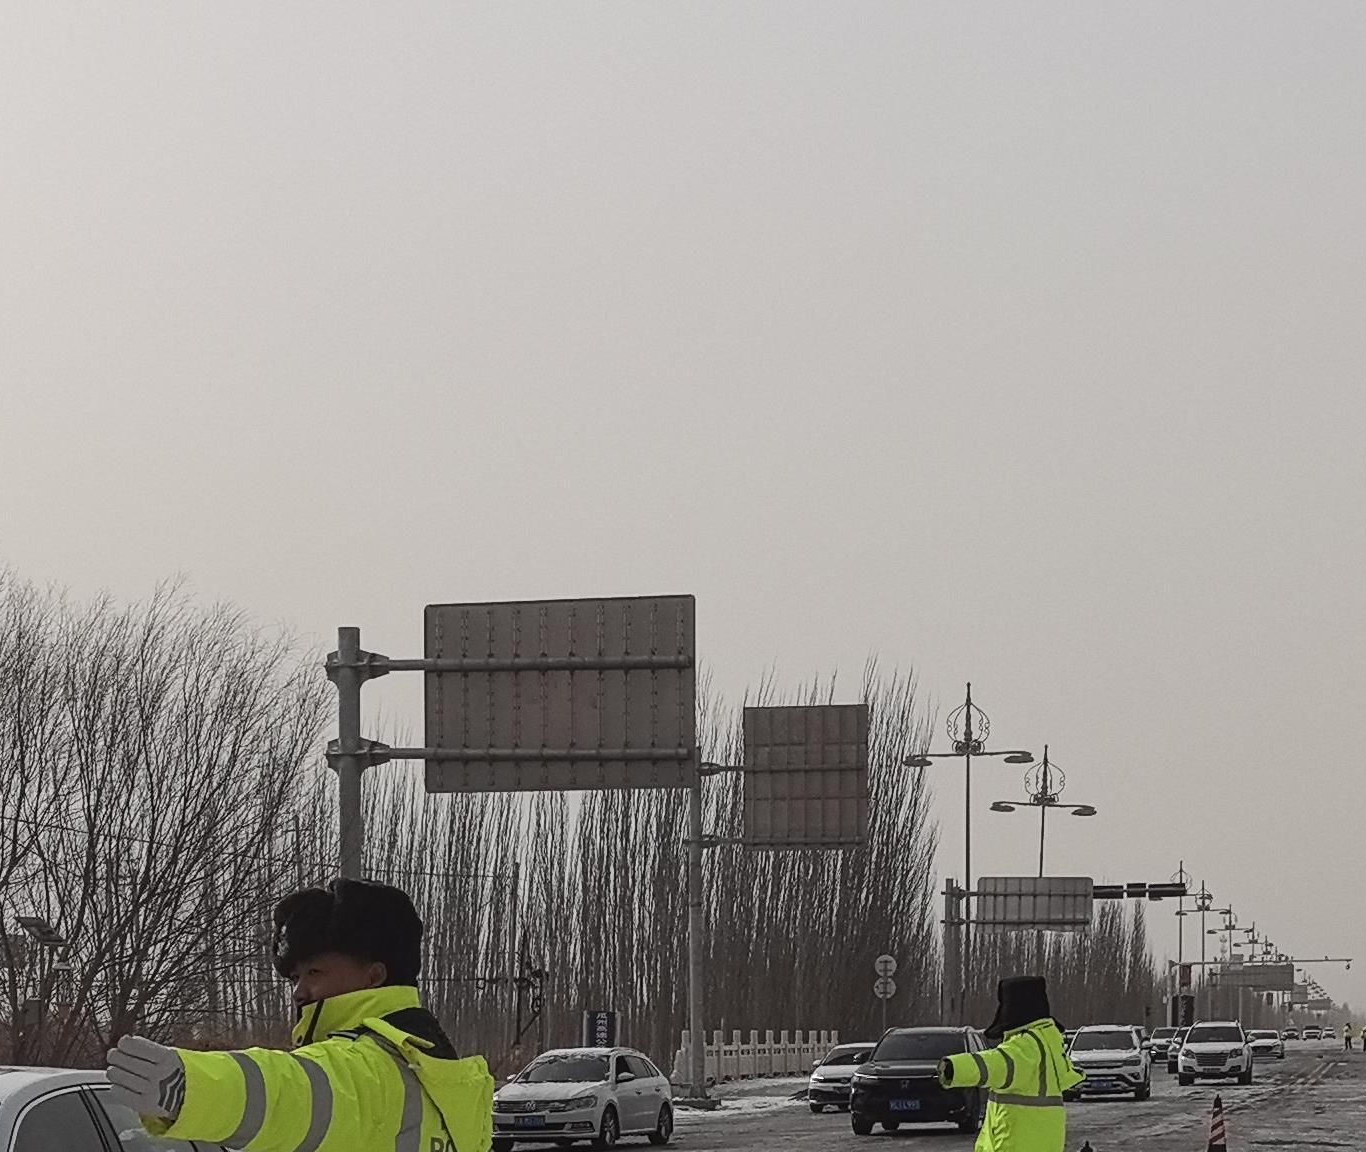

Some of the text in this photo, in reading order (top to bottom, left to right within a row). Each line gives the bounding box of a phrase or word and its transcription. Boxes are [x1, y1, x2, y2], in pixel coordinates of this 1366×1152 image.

[595, 1012, 608, 1047] 瓜州高速公
